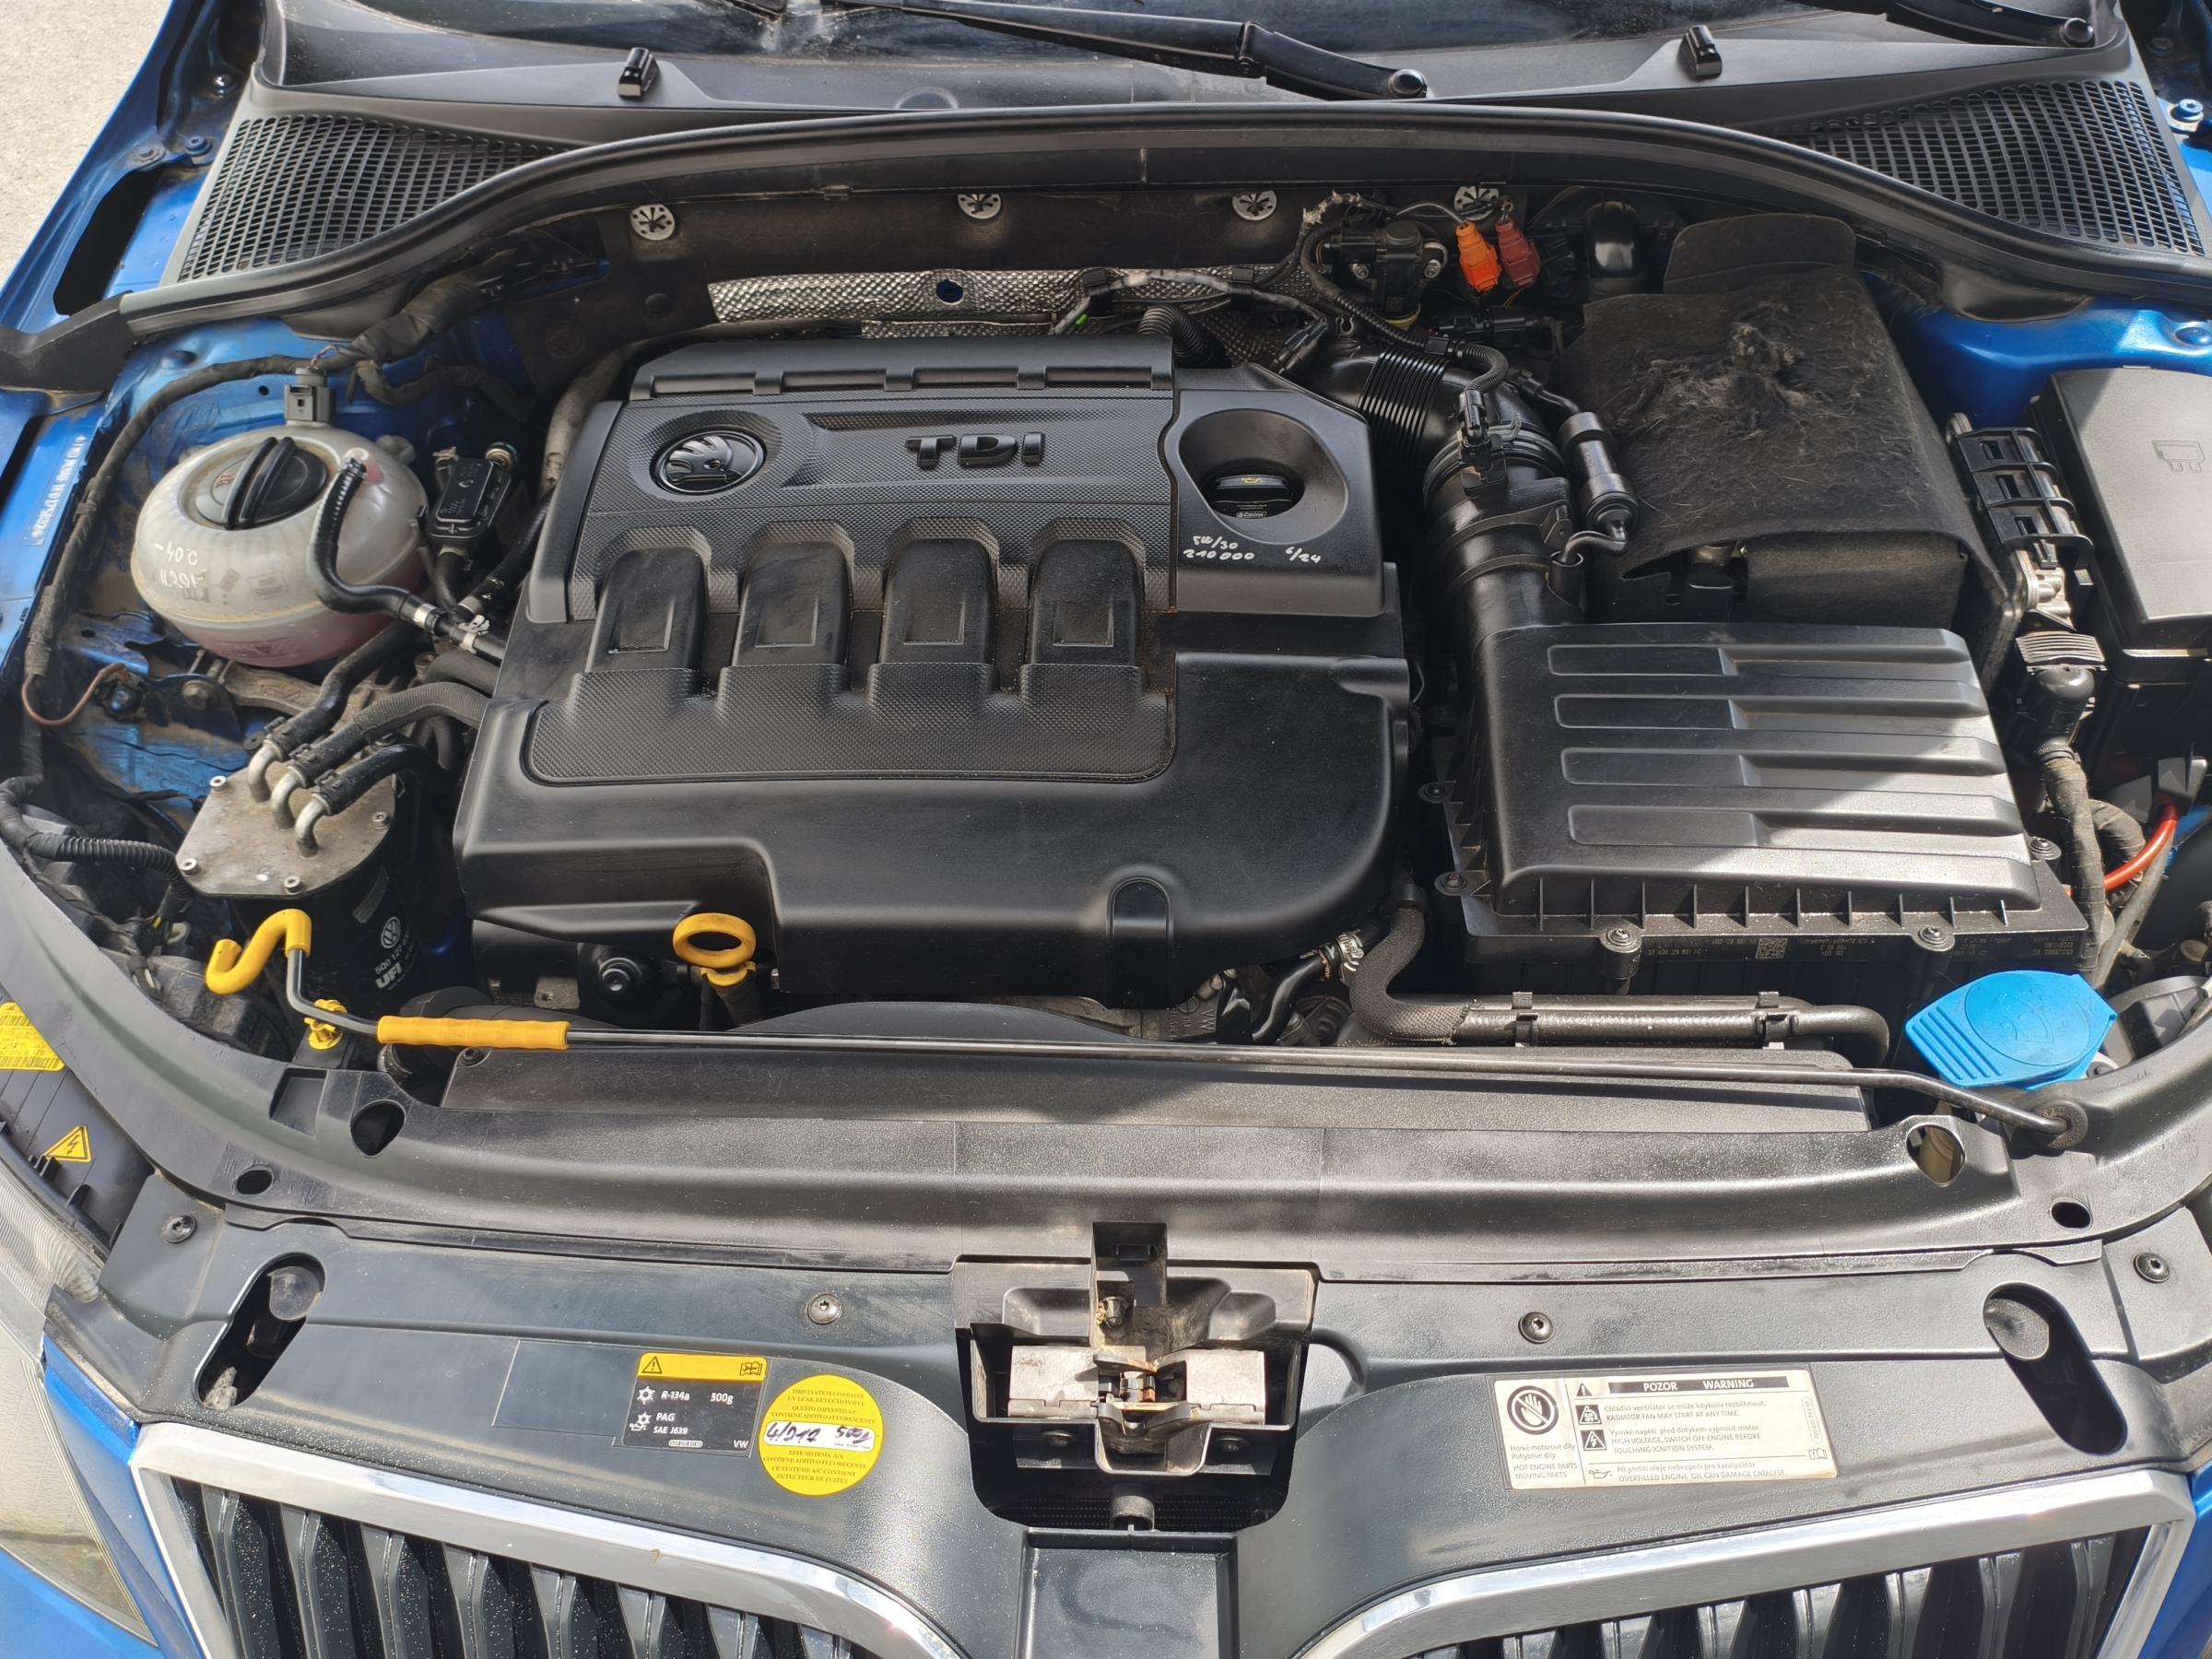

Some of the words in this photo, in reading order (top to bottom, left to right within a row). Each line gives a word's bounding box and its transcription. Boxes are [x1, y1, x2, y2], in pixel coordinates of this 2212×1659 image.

[904, 431, 1045, 470] TDI
[375, 962, 402, 989] UFI
[1643, 1382, 1677, 1391] POZOR
[1703, 1379, 1754, 1389] WARNING
[661, 1390, 690, 1401] R-134a
[711, 1393, 734, 1405] 500g
[656, 1413, 676, 1421] PAG
[653, 1426, 668, 1434] SAE
[734, 1440, 749, 1448] VW
